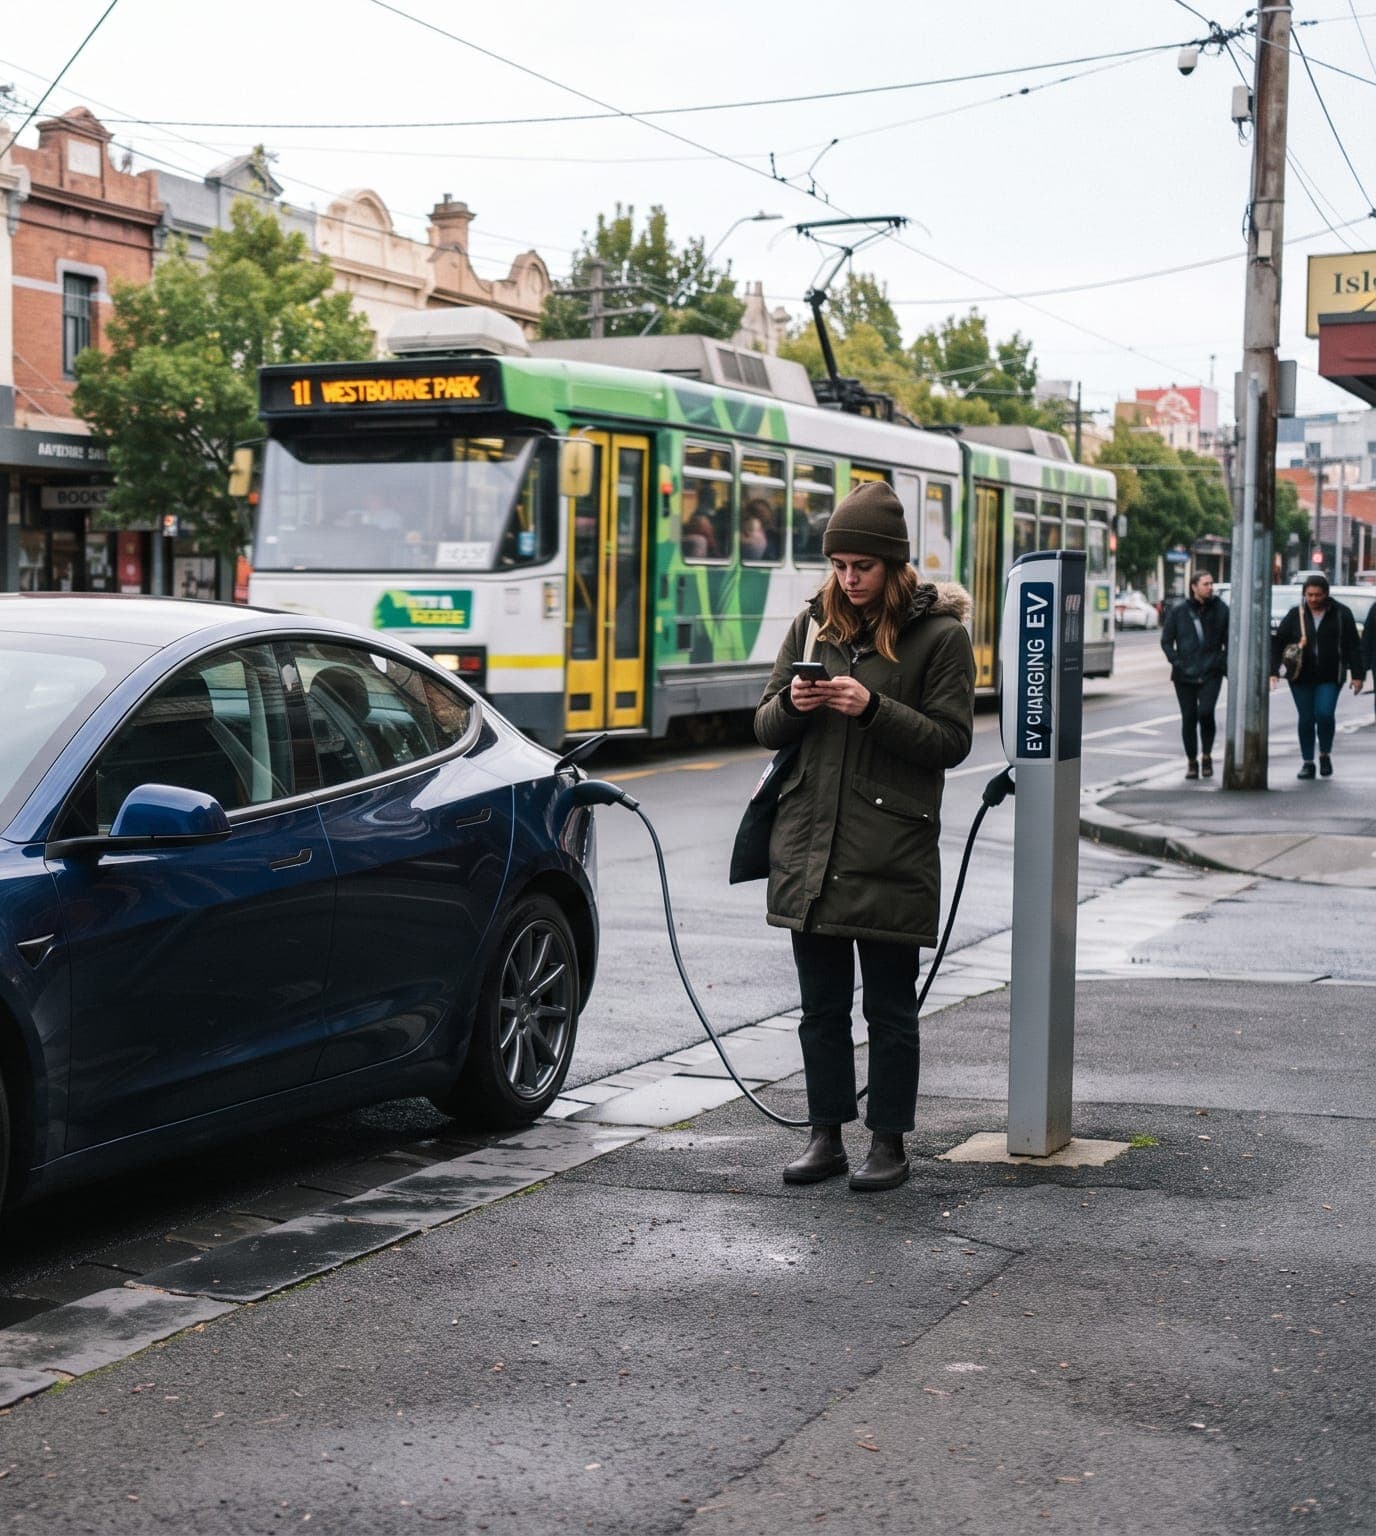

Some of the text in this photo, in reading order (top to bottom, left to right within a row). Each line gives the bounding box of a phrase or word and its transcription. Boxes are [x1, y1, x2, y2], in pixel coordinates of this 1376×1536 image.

[1333, 270, 1376, 295] Isl
[321, 379, 432, 403] WESTBOURNE
[433, 376, 481, 399] PARK
[1026, 591, 1049, 629] EV
[1026, 729, 1043, 751] EV
